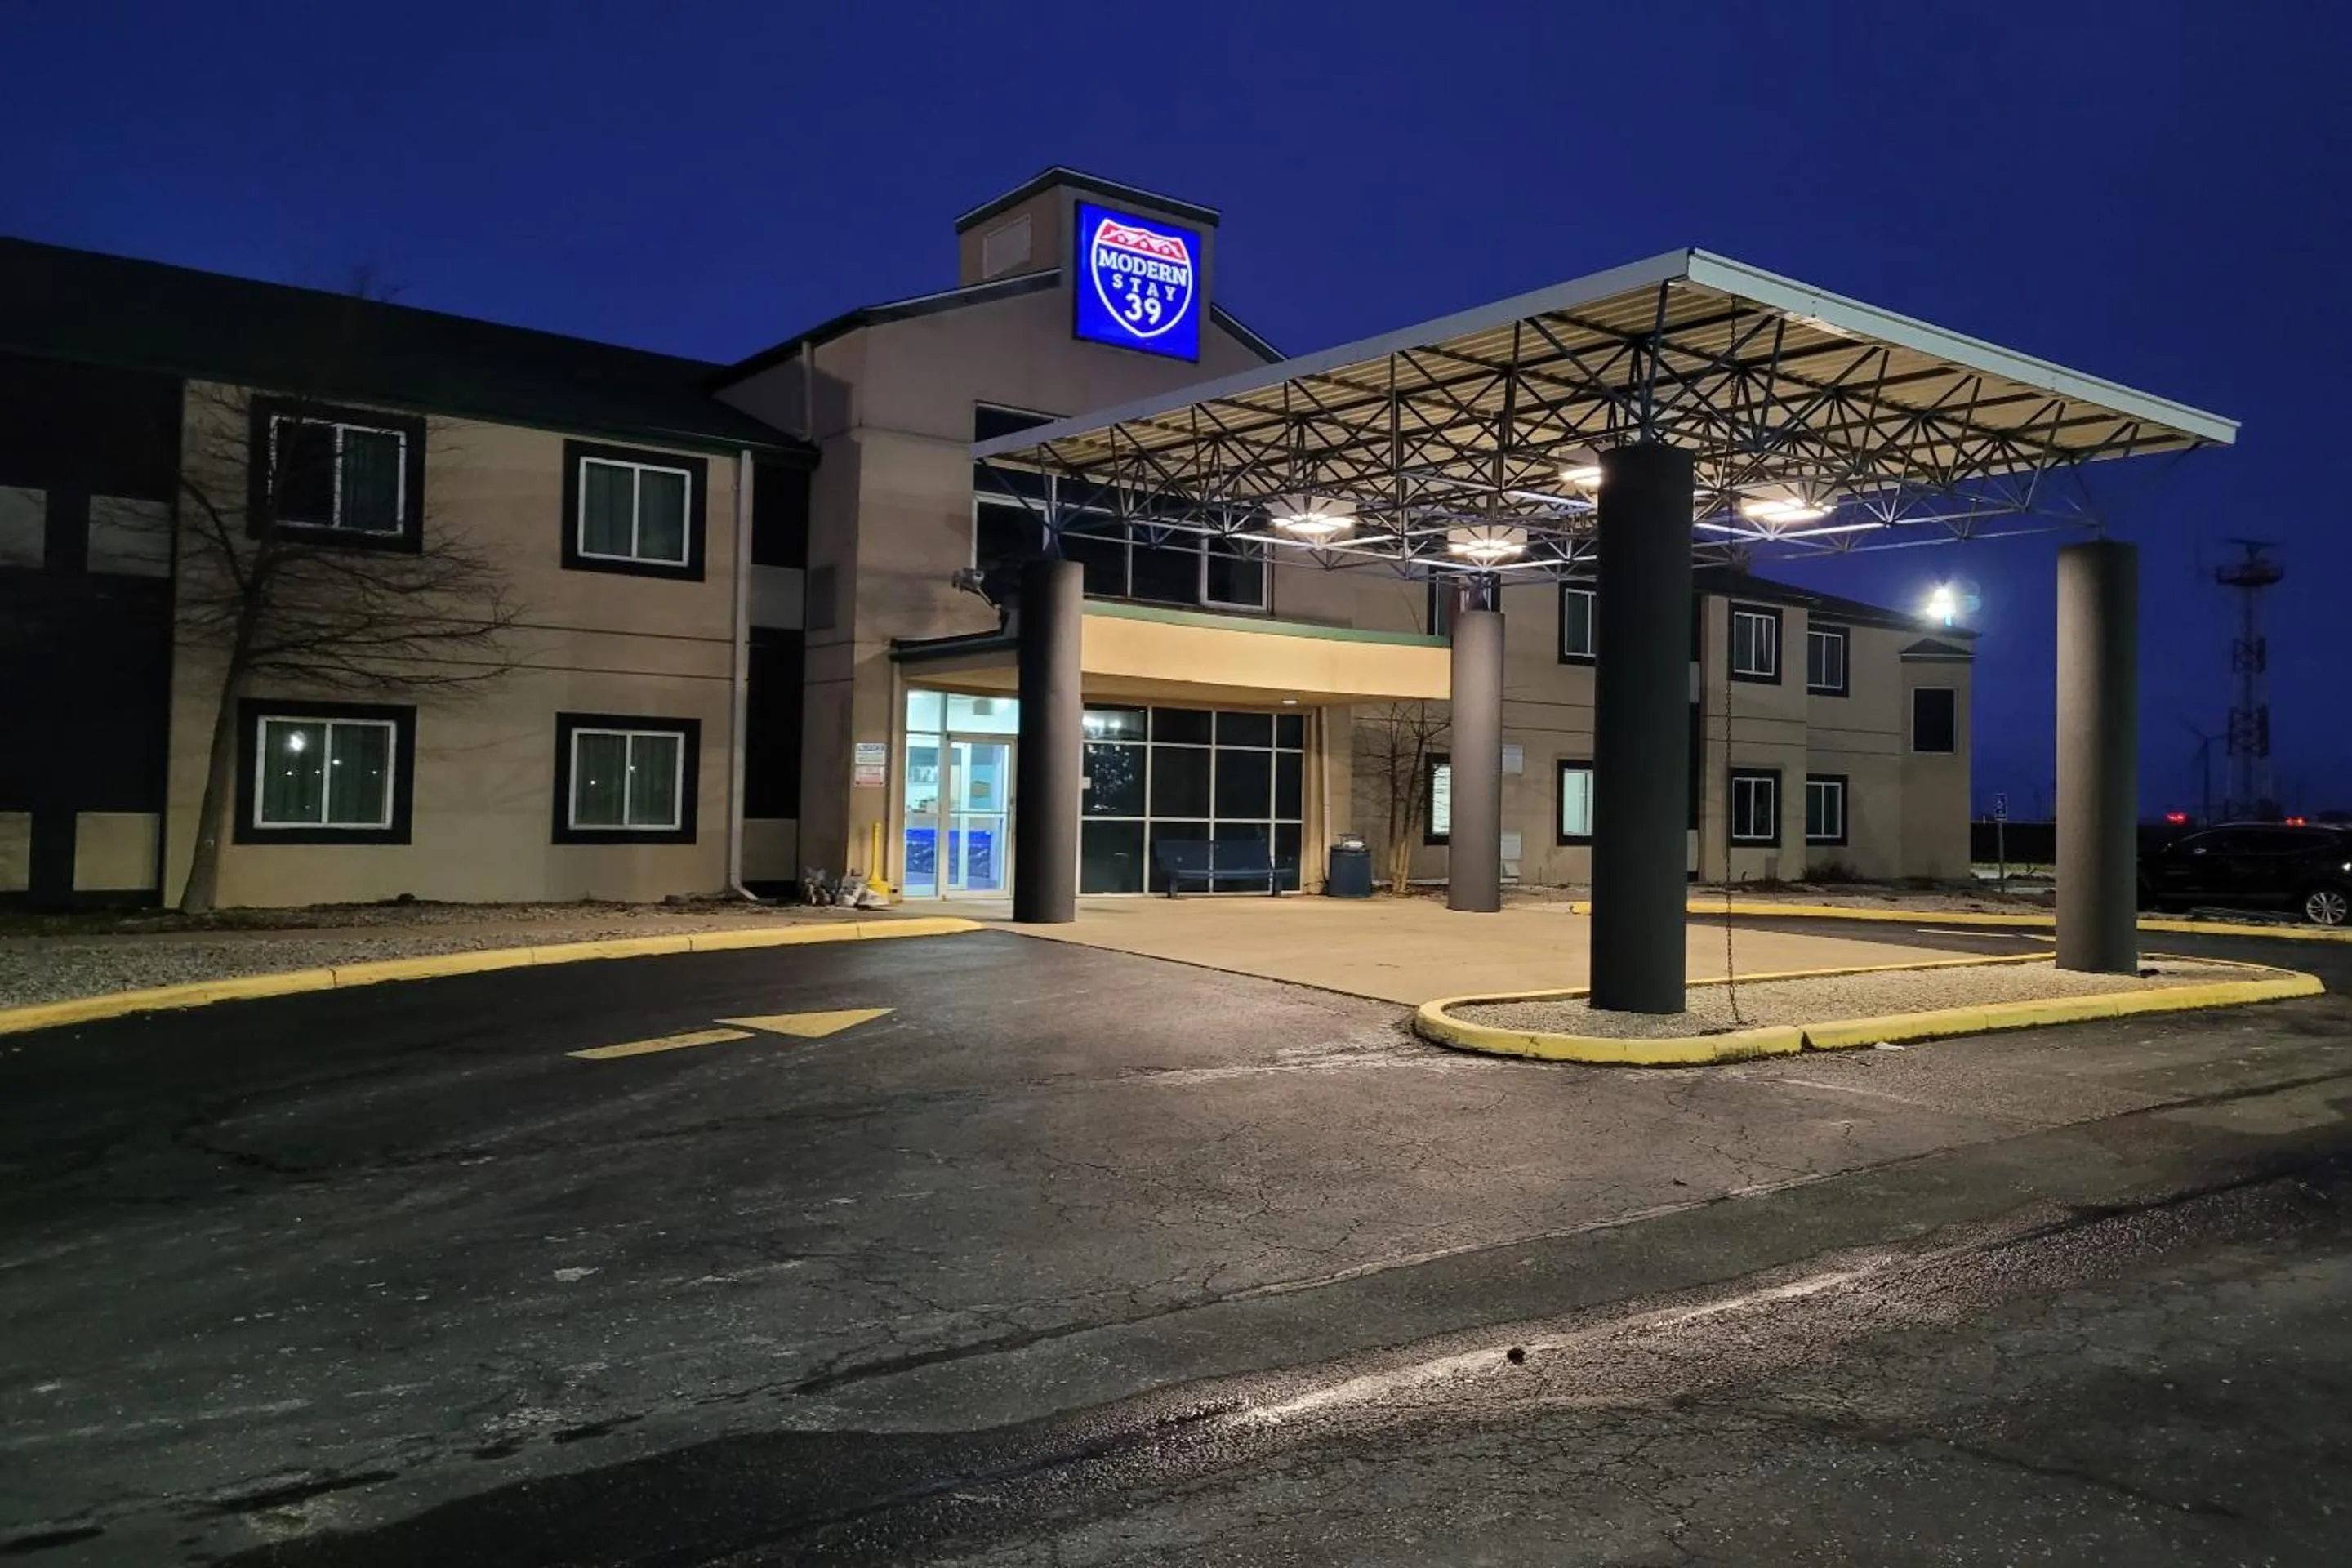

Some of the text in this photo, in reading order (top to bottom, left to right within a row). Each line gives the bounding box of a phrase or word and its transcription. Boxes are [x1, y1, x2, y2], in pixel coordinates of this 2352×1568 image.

[1098, 248, 1187, 287] MODERN
[1112, 274, 1176, 301] STAY
[1124, 293, 1162, 324] 39
